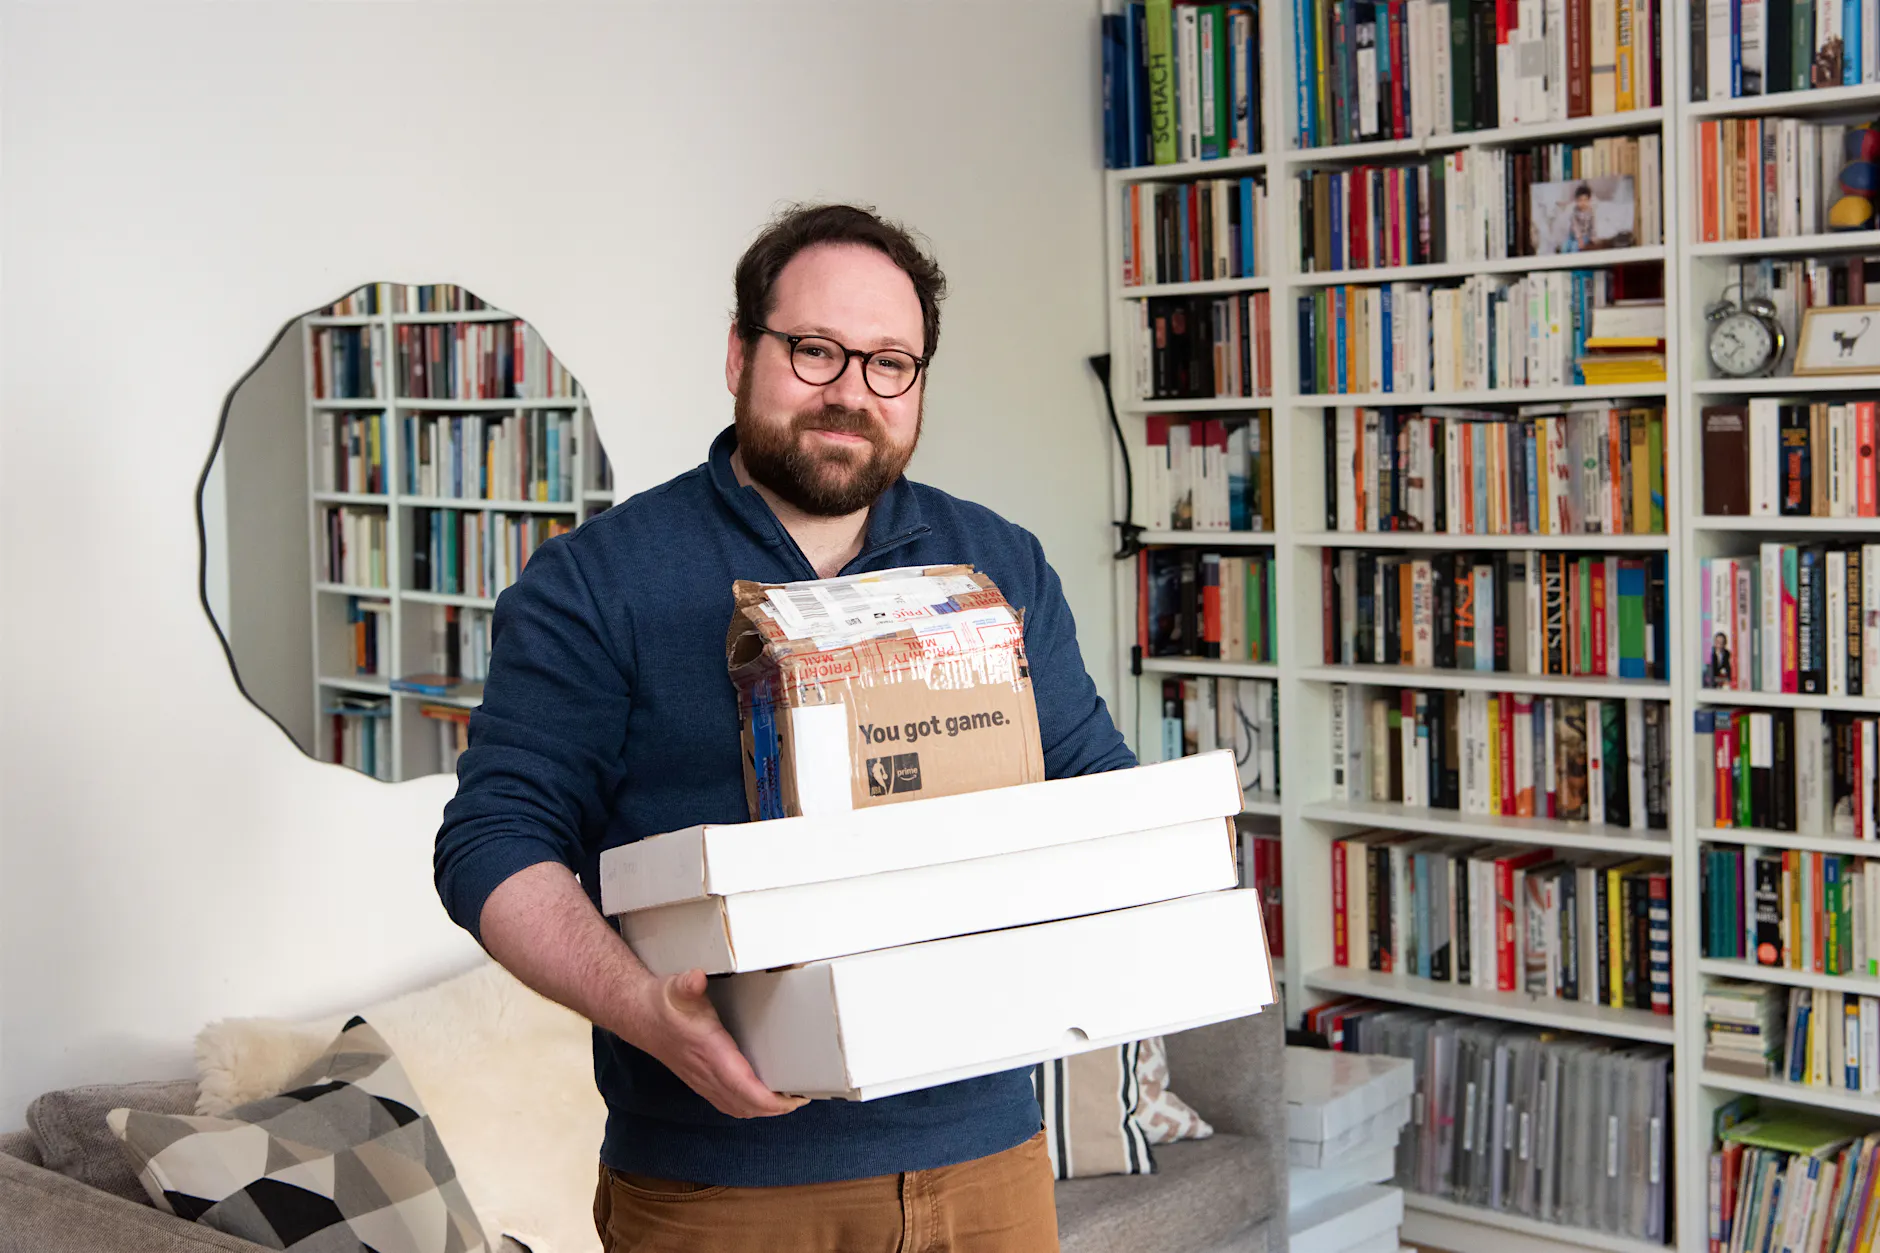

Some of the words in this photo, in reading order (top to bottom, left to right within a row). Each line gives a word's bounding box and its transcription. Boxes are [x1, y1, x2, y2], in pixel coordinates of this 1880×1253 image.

[1151, 54, 1169, 143] SCHACH
[1801, 586, 1811, 623] STANLEY
[800, 654, 834, 666] MAIL
[904, 638, 937, 651] MAIL
[1801, 625, 1811, 671] ROBINSON
[859, 723, 900, 745] You
[904, 715, 942, 743] got
[945, 710, 1011, 737] game.
[896, 766, 919, 778] prime
